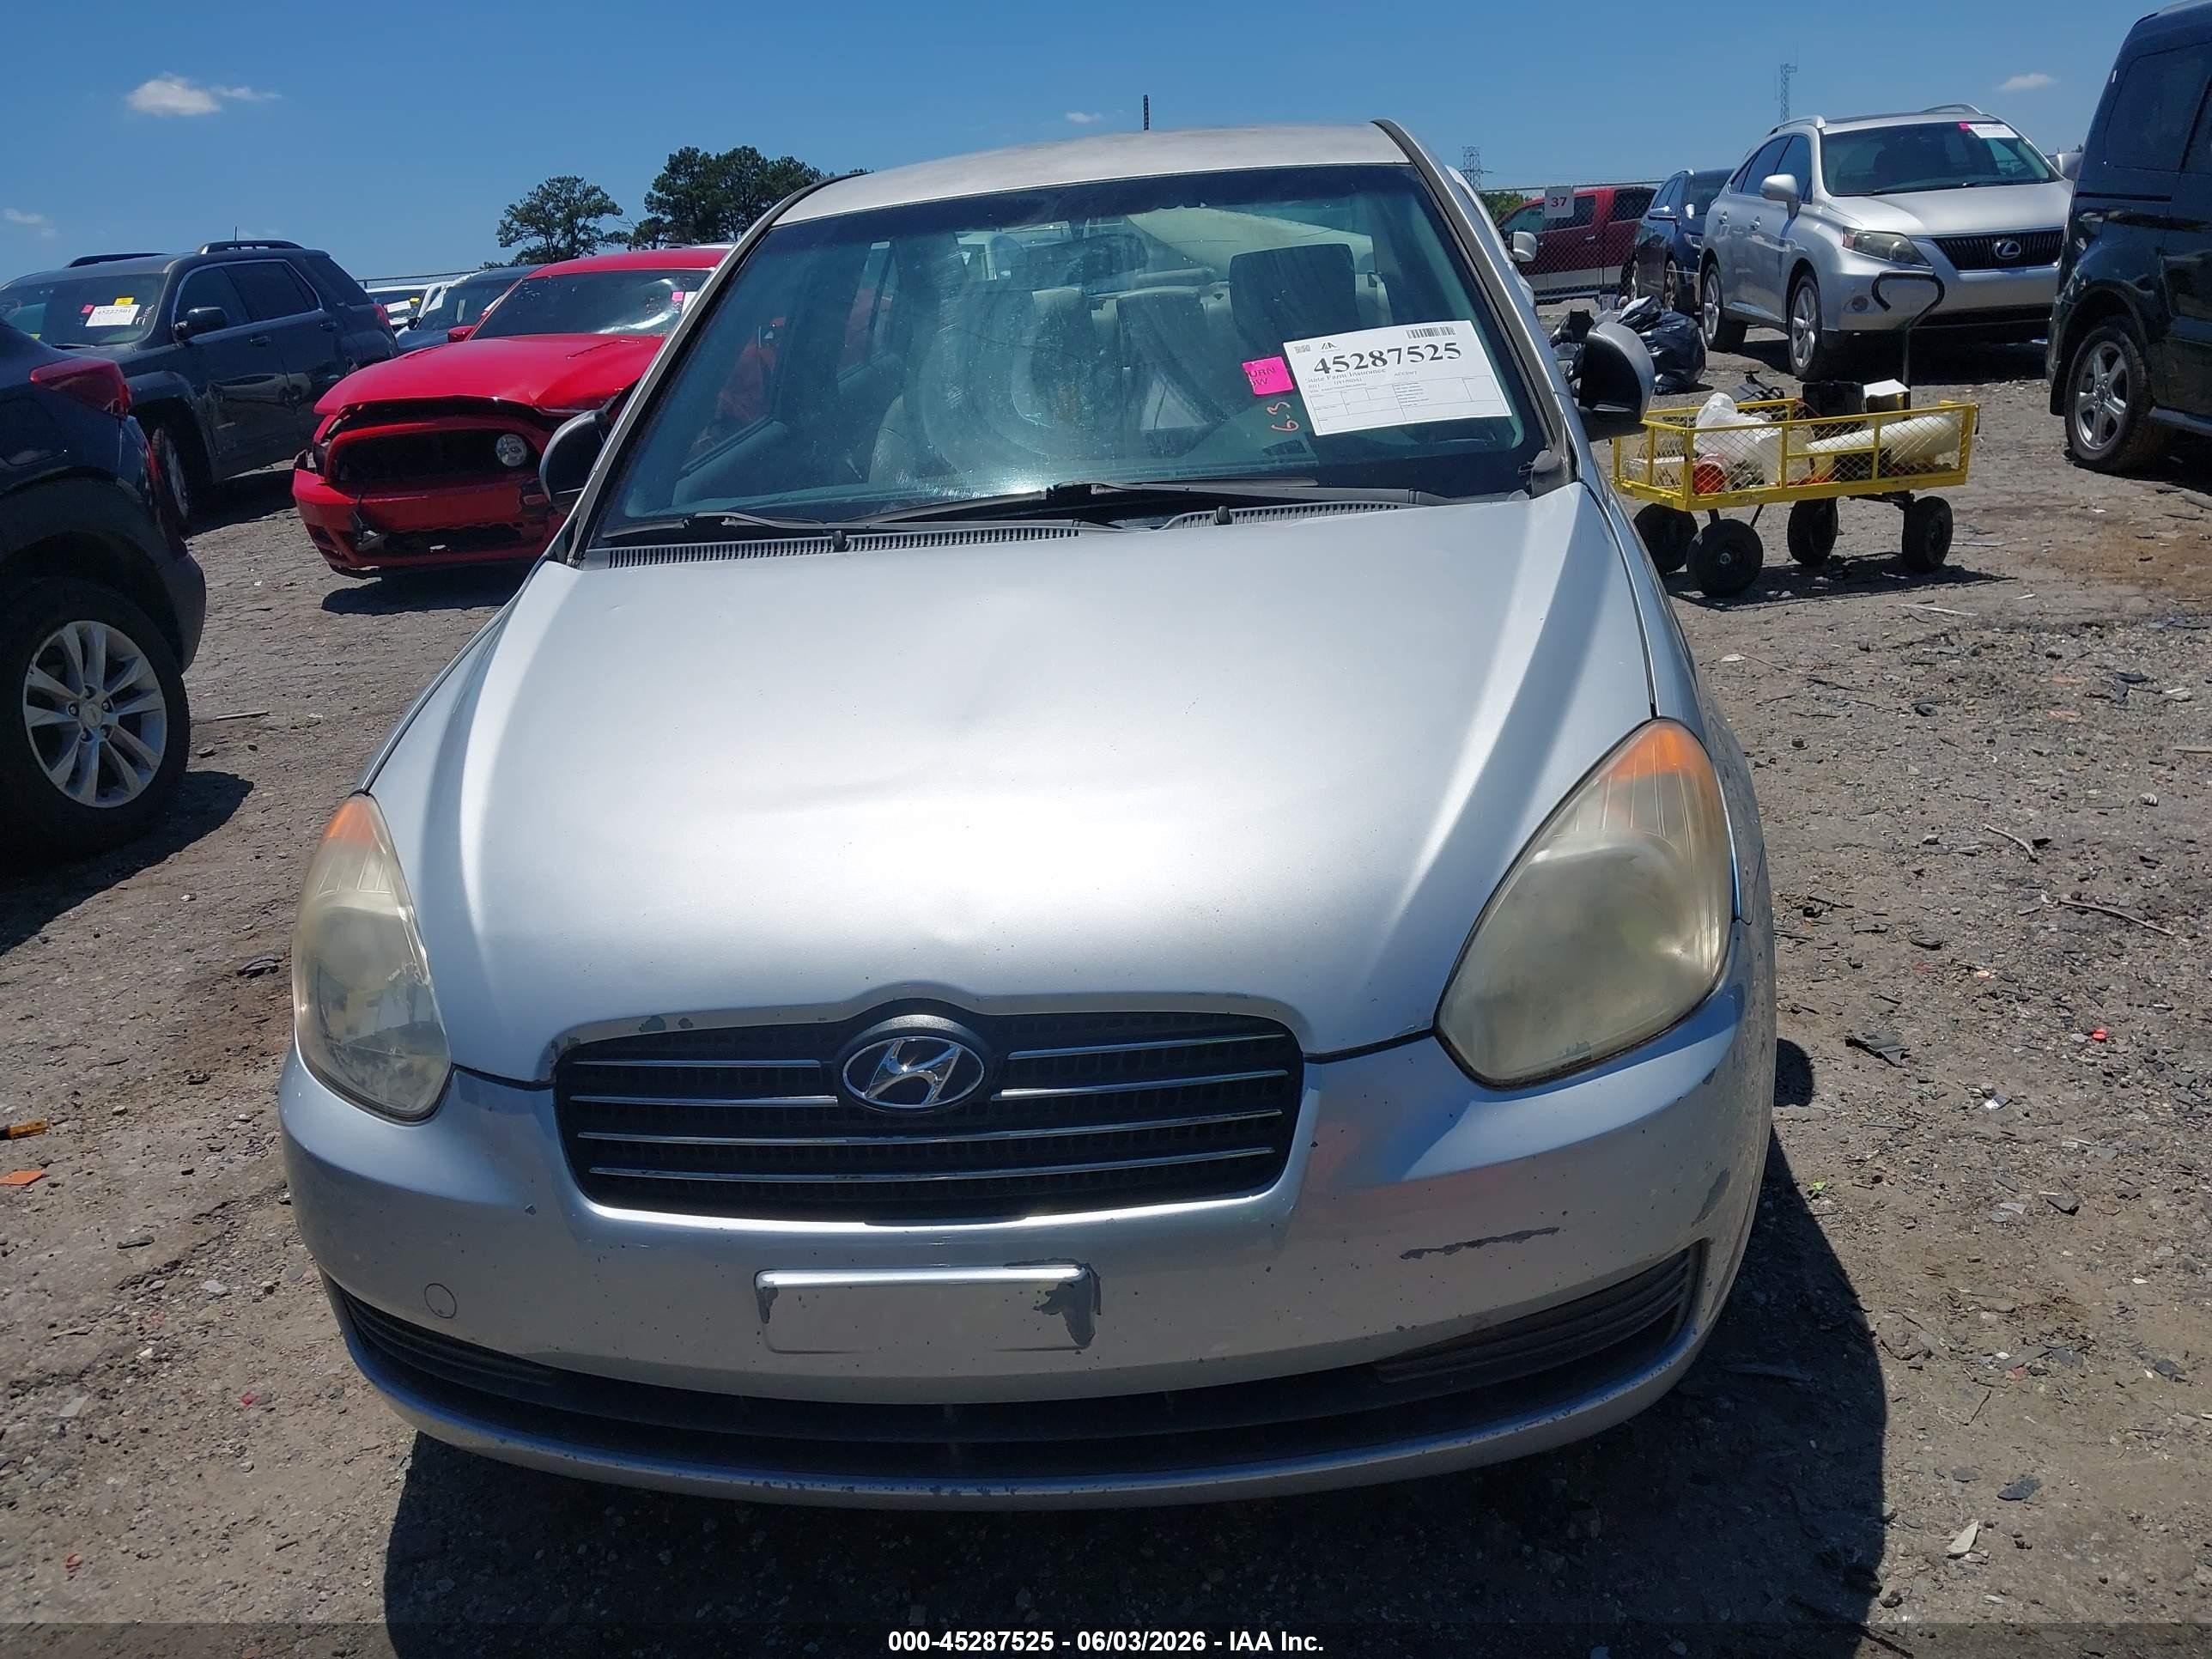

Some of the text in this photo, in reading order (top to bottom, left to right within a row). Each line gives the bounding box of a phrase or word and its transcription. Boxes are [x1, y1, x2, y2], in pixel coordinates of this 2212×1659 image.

[1551, 197, 1567, 207] 37
[1314, 342, 1462, 374] 45287525
[1305, 368, 1387, 384] State Farm Insurance
